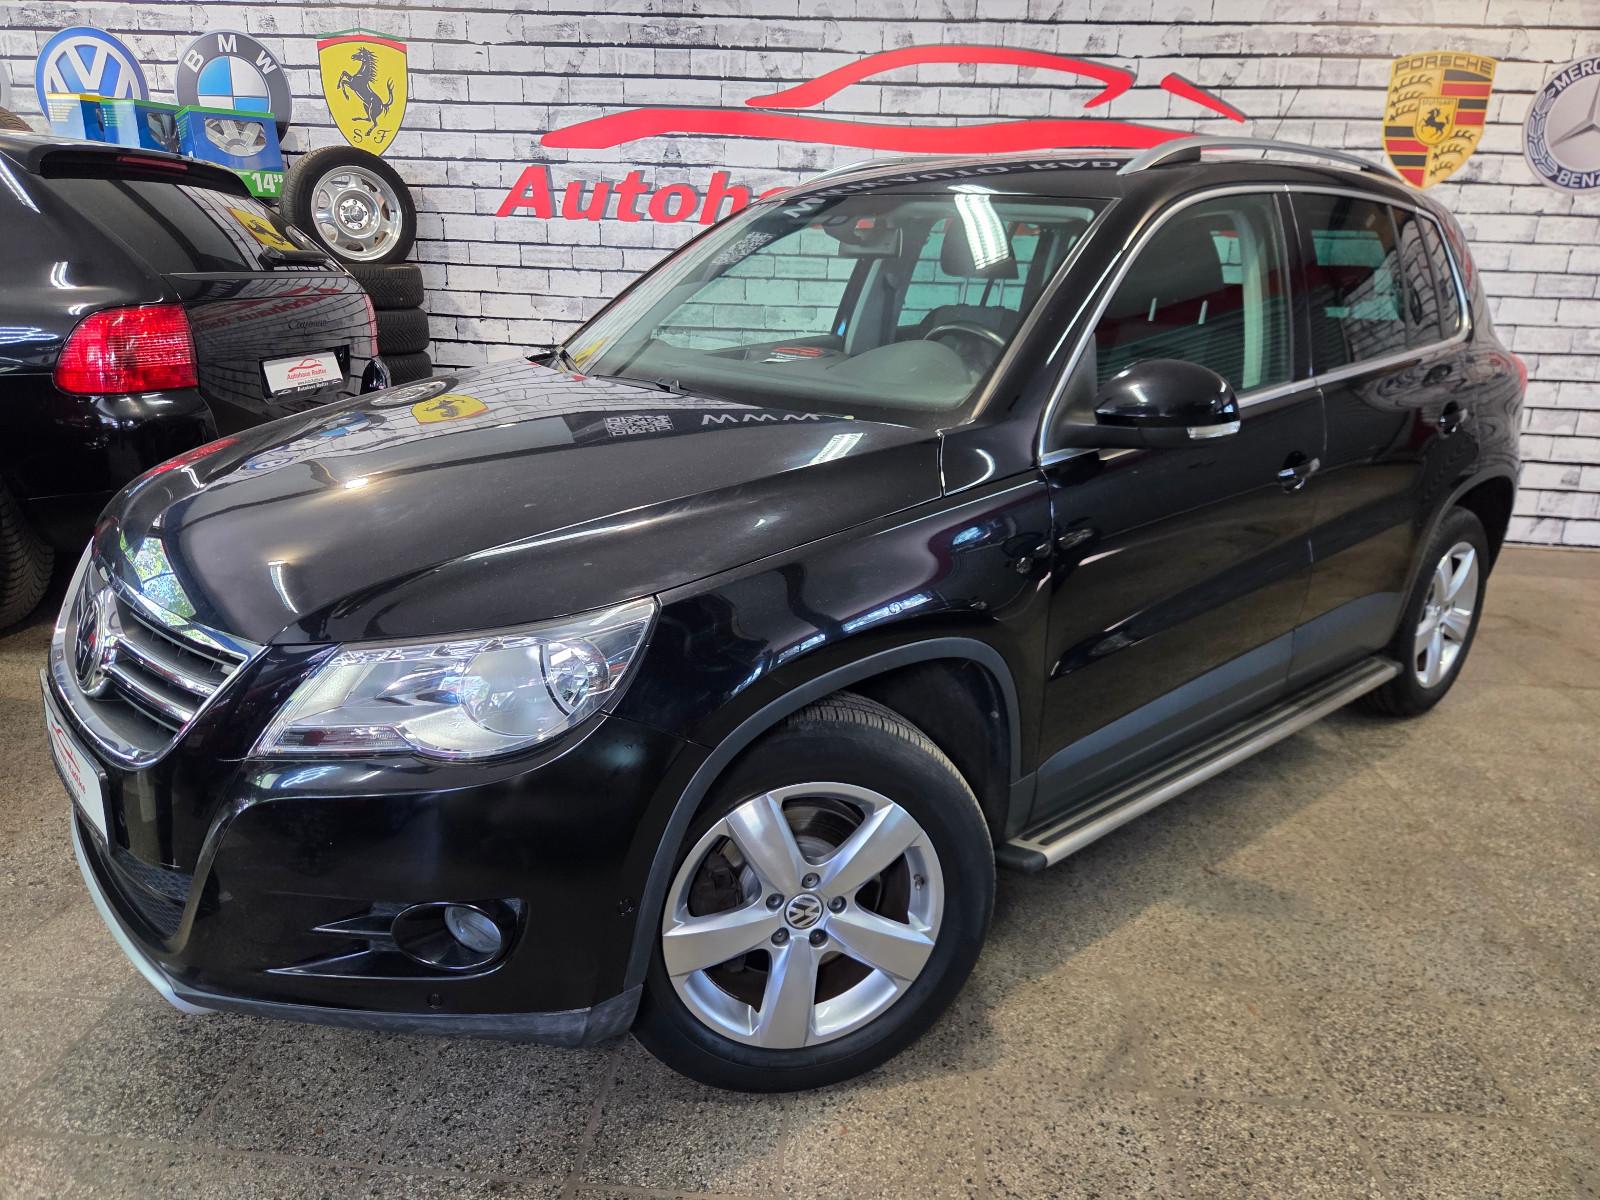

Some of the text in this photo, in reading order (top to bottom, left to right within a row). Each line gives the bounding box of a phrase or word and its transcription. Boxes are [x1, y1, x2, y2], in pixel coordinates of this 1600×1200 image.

[184, 33, 279, 75] BMW
[1394, 55, 1493, 76] PORSCHE
[496, 164, 792, 225] Autoh
